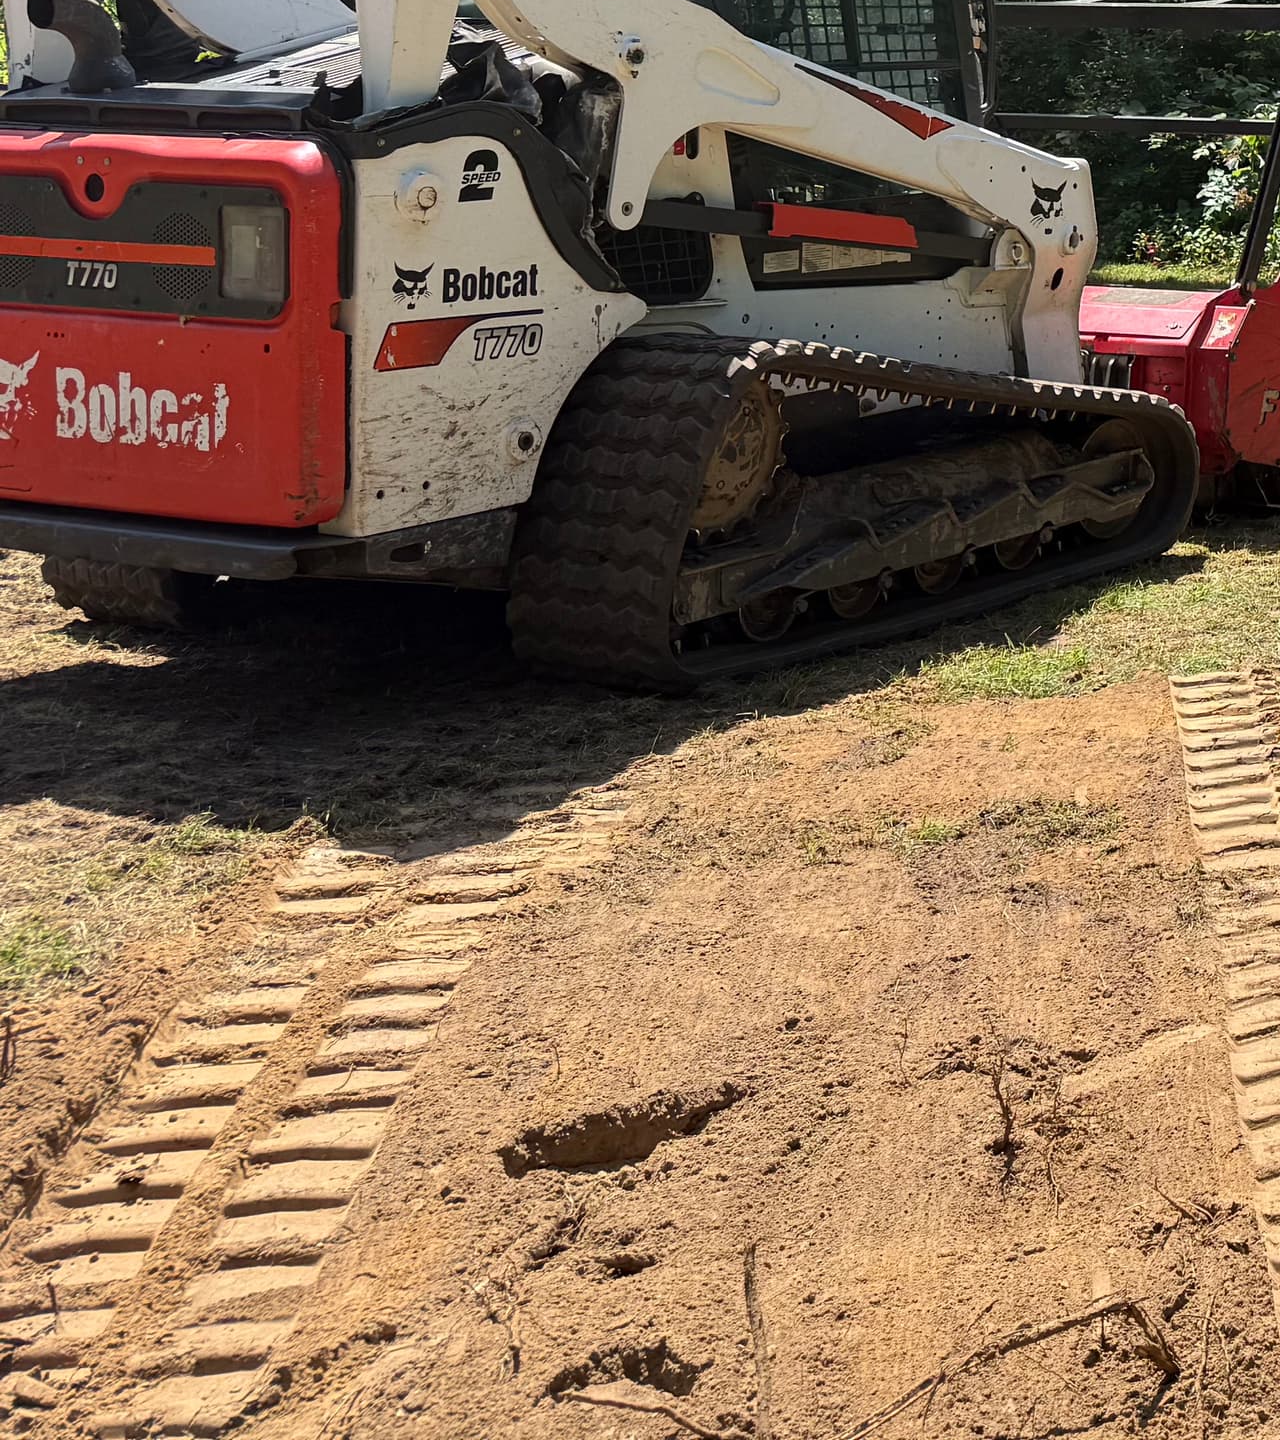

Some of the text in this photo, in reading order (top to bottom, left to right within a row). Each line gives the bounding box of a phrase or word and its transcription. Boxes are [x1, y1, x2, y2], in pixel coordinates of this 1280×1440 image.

[458, 149, 499, 203] 2
[461, 171, 501, 185] SPEED
[66, 260, 118, 289] T770
[442, 264, 539, 303] Bobcat
[473, 323, 544, 361] T770
[55, 366, 230, 452] Bobcat
